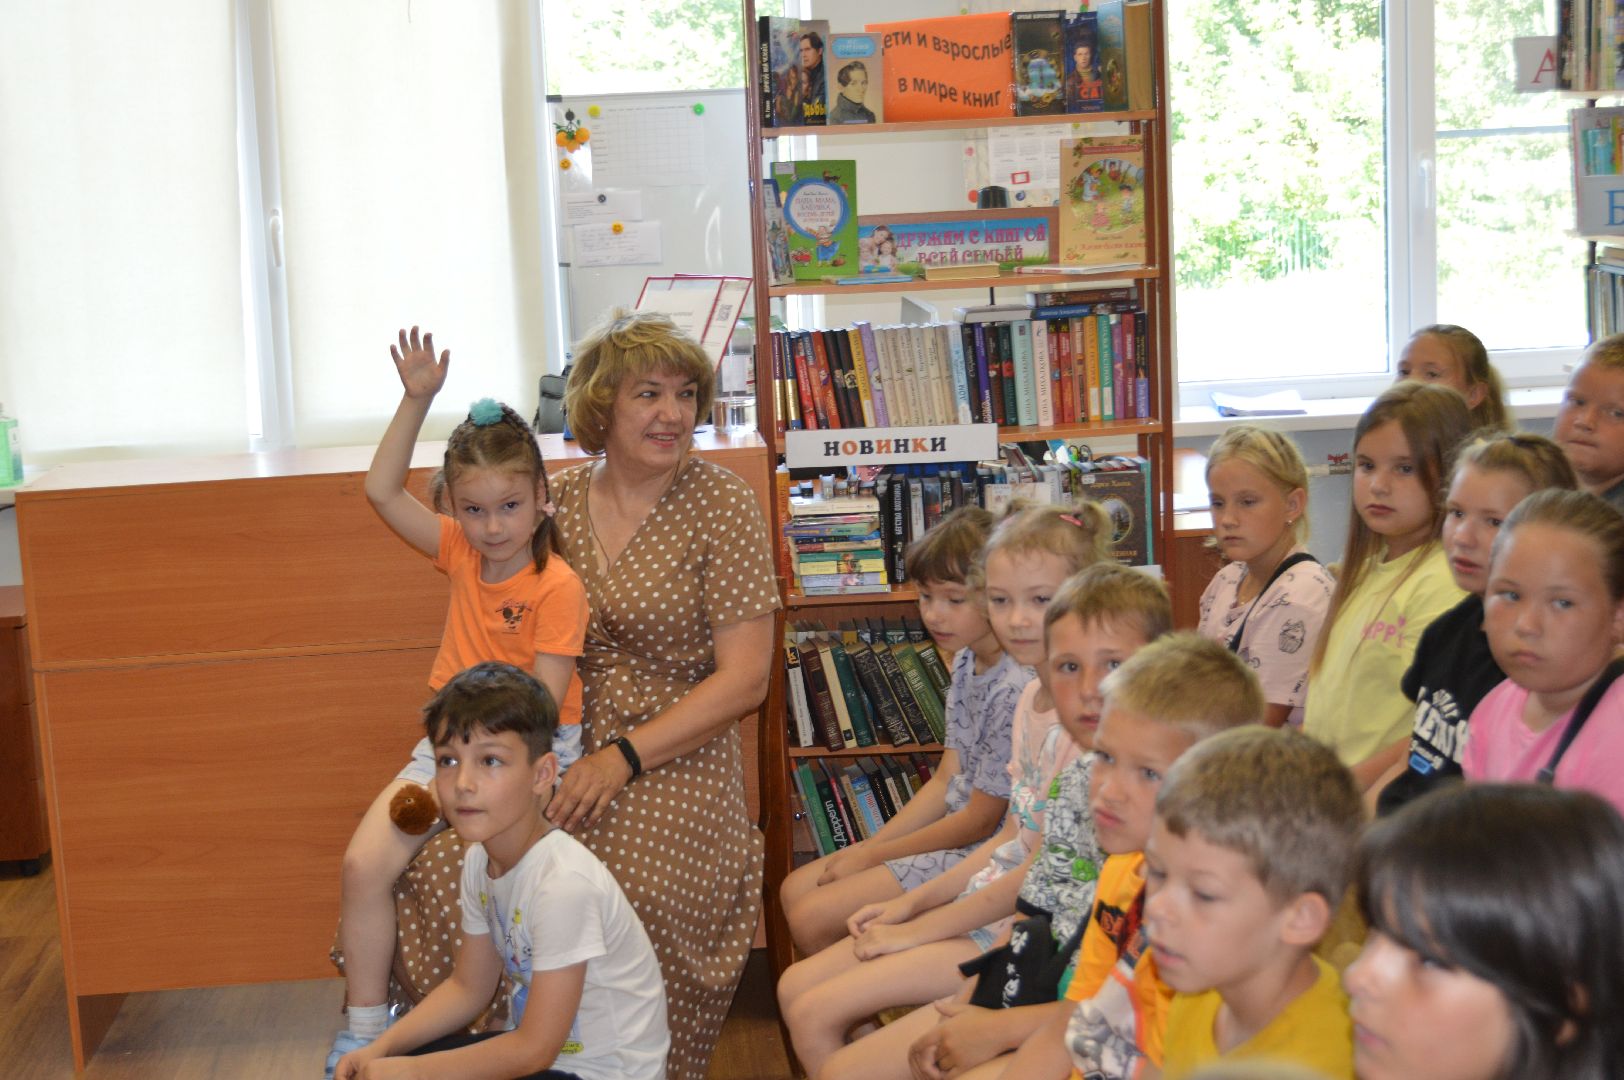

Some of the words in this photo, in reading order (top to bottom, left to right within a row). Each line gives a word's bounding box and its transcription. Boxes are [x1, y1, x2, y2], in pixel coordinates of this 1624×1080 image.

[881, 31, 912, 56] ети
[916, 31, 927, 48] и
[932, 33, 1011, 61] взрослые
[897, 77, 908, 93] в
[962, 90, 1002, 108] книг
[984, 223, 1047, 244] КНИГОЙ
[824, 436, 946, 457] НОВИНКИ
